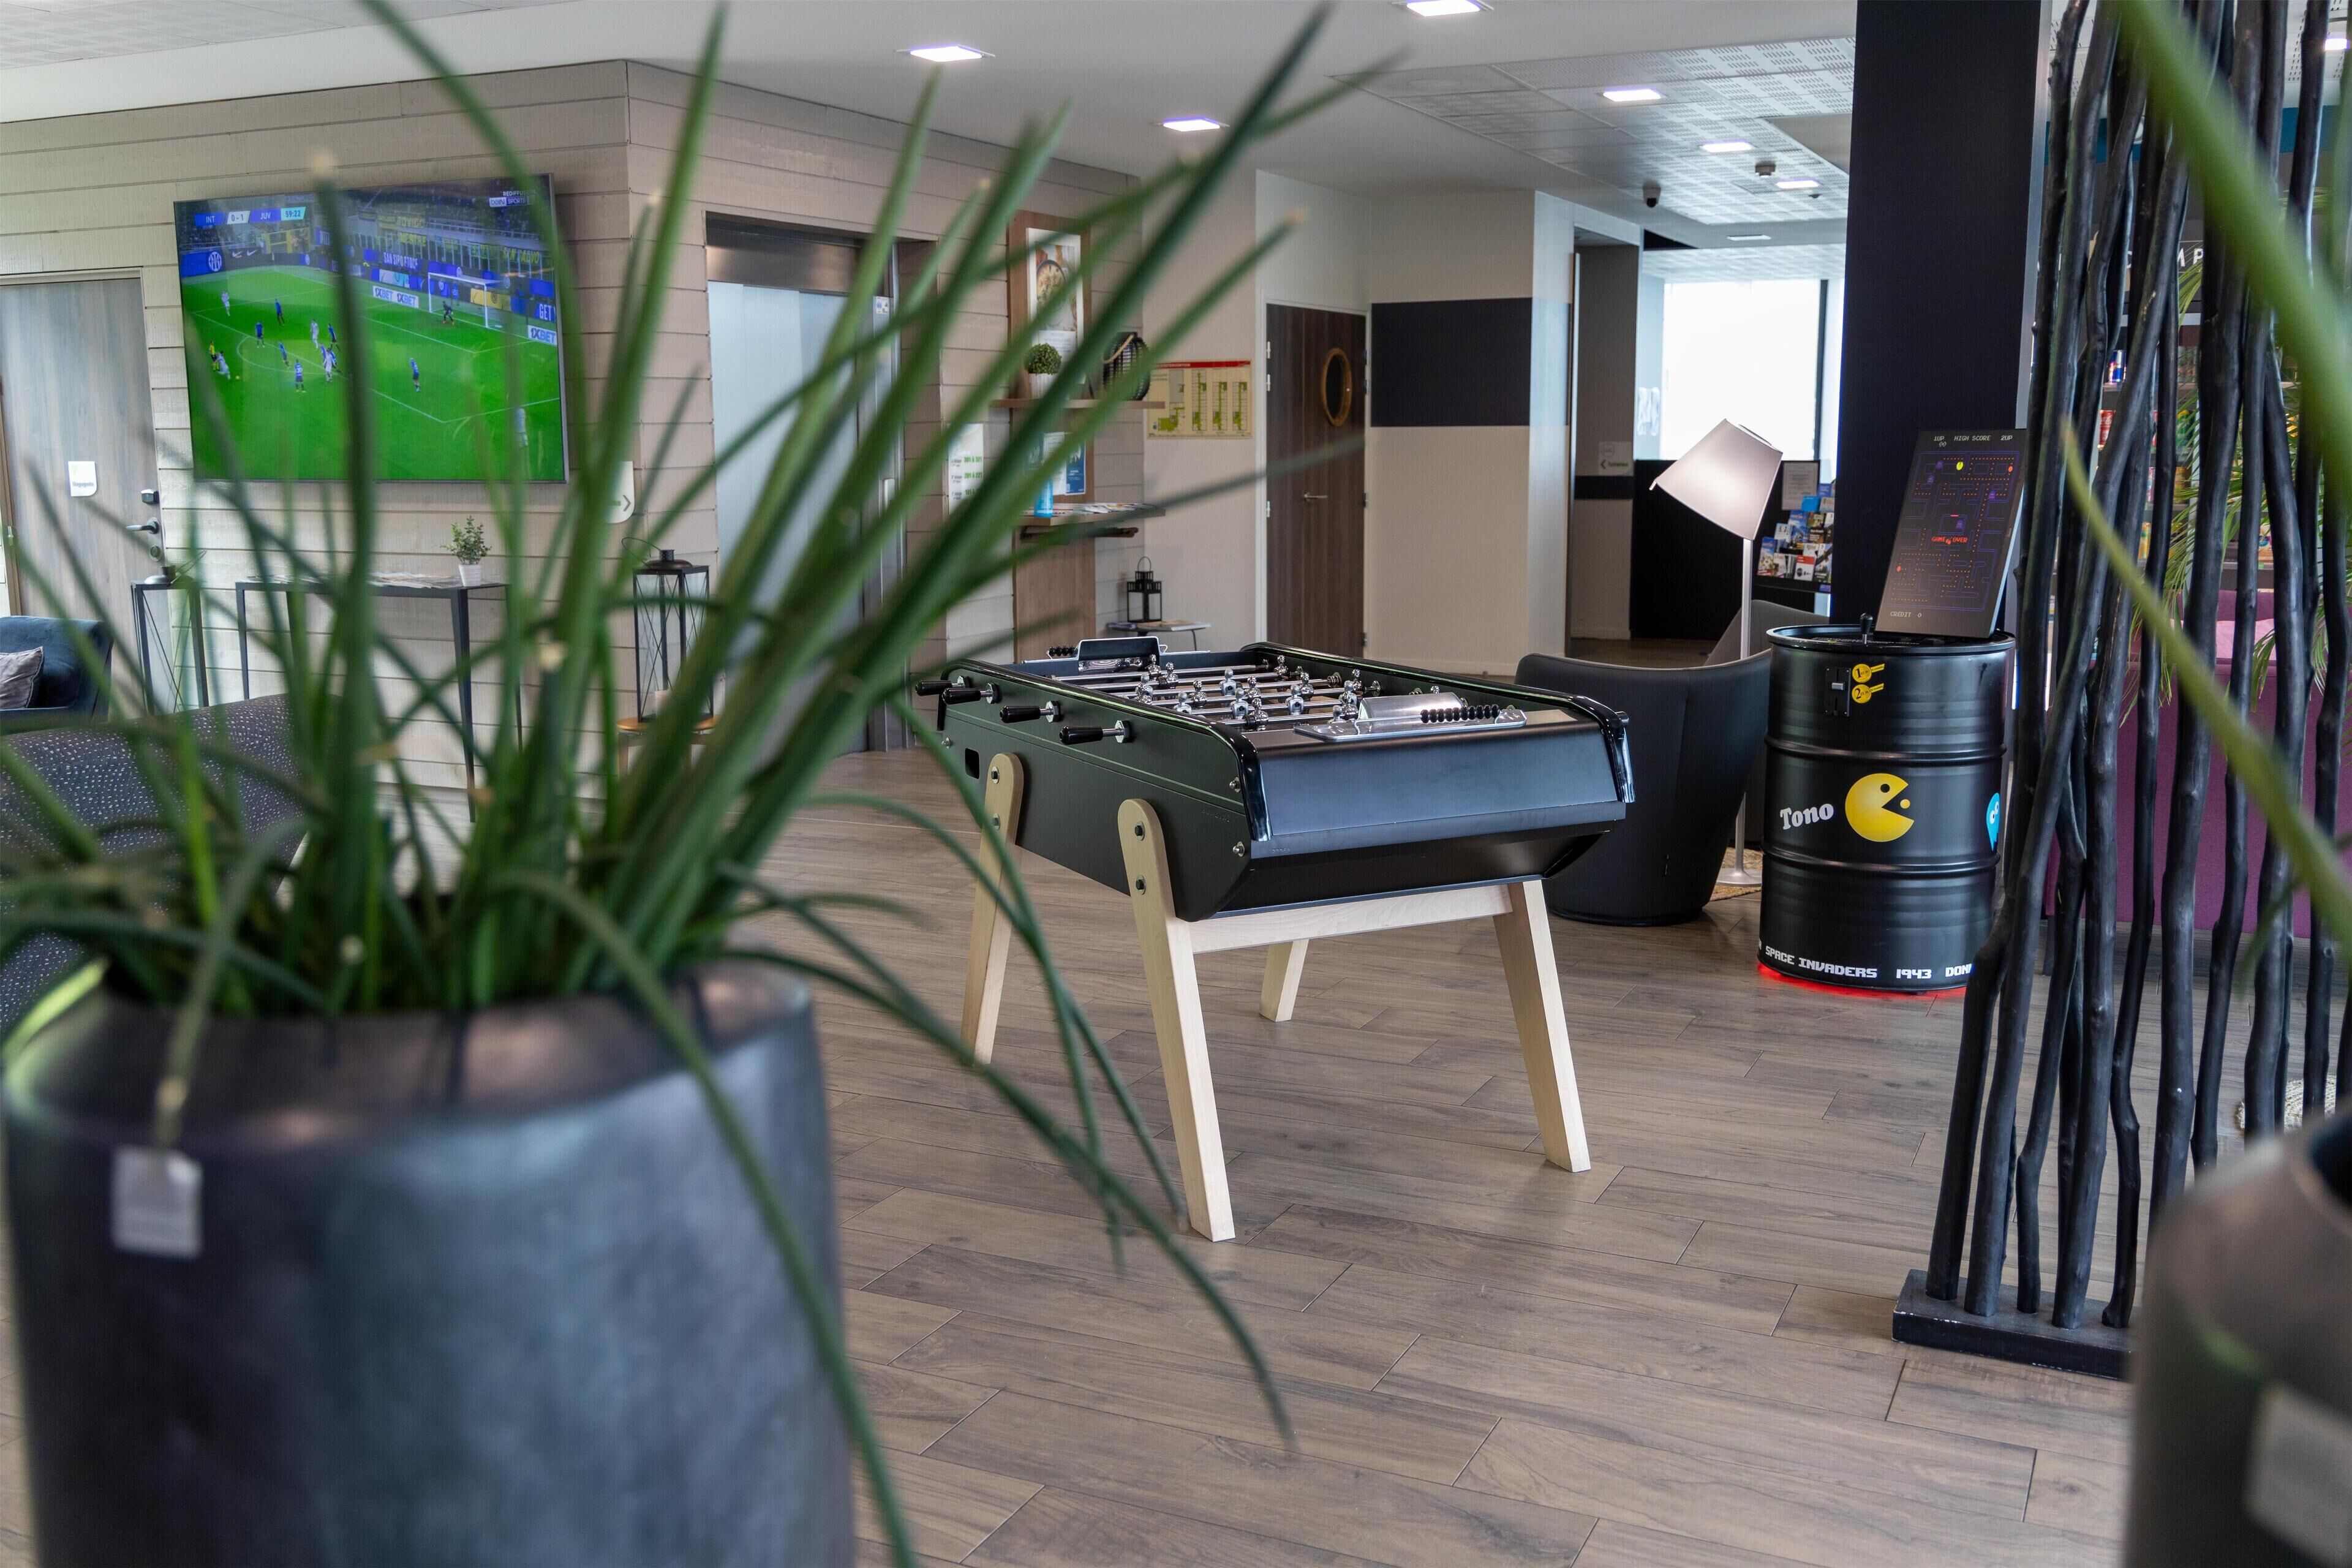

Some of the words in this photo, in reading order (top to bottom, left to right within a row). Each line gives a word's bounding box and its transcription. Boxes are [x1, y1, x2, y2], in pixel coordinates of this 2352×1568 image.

[375, 287, 394, 301] 1XBET
[398, 293, 417, 306] 1XBET
[539, 303, 552, 322] GET
[530, 328, 556, 343] 1XBET
[1855, 688, 1861, 699] 2
[1779, 804, 1834, 830] Tono
[1765, 945, 1795, 965] SPACE
[1798, 957, 1878, 979] INVADERS
[1896, 968, 1932, 979] 1943
